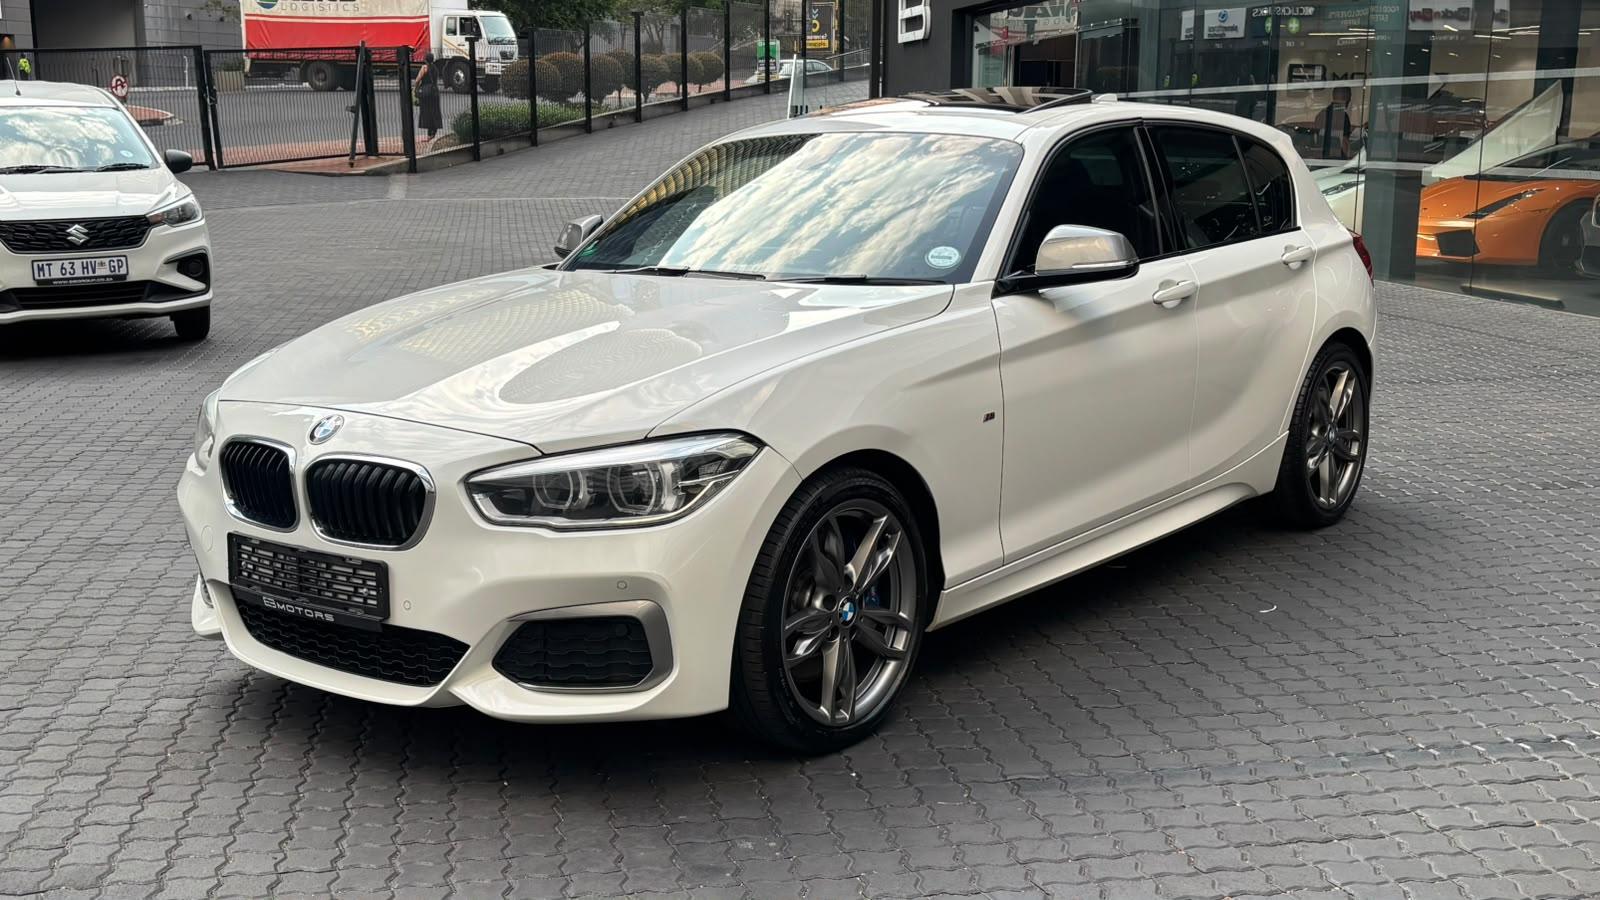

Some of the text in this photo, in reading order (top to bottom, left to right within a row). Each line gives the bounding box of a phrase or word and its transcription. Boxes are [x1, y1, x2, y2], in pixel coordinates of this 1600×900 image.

[280, 3, 360, 12] LOGISTICS
[37, 259, 124, 278] MT 63 HV GP
